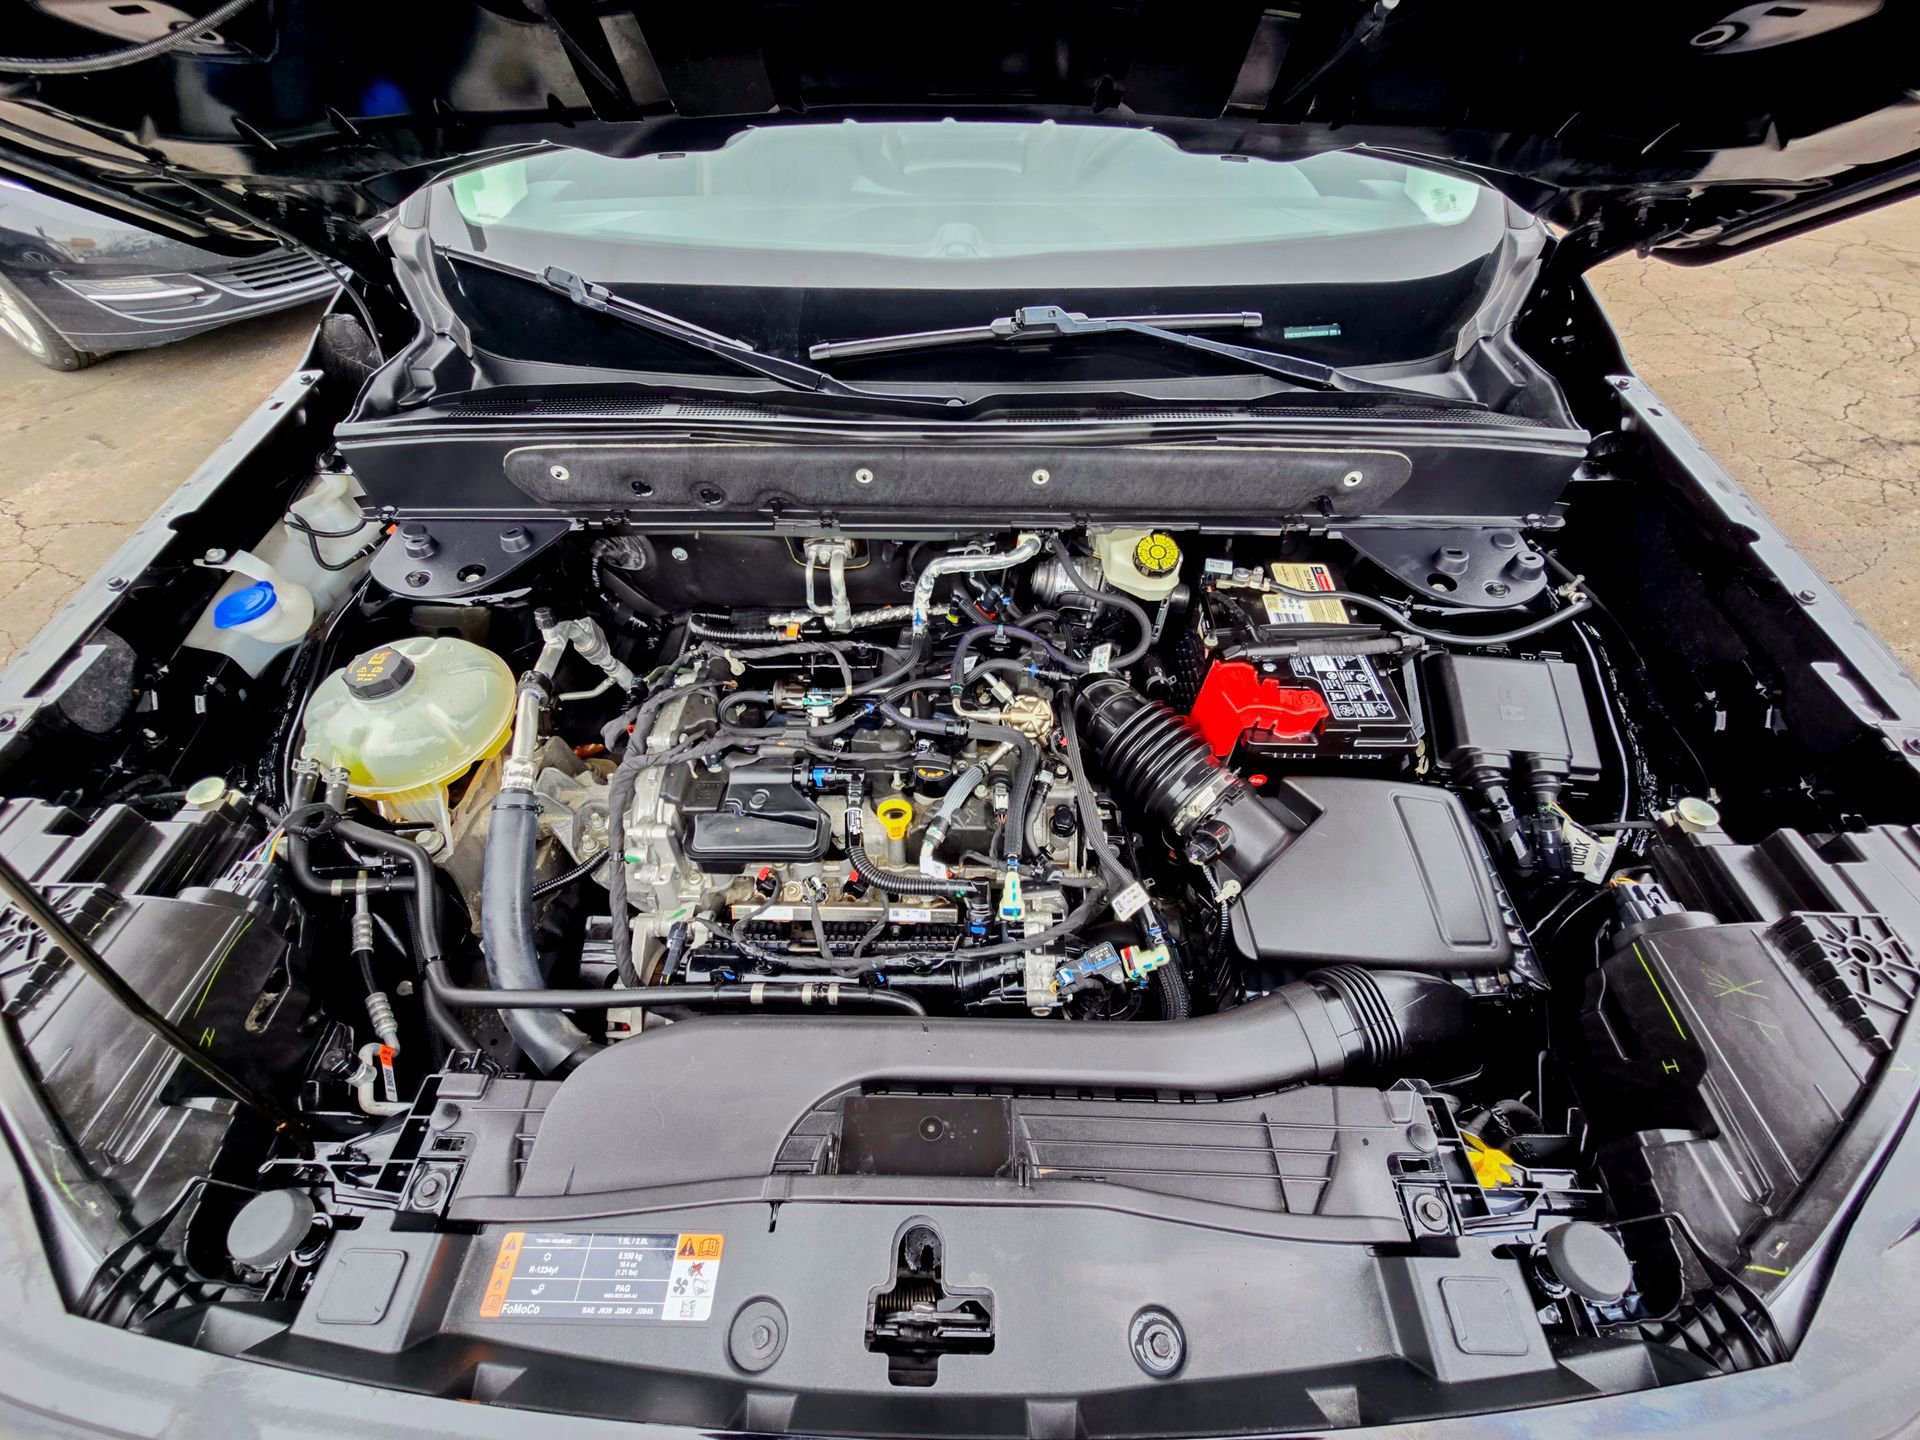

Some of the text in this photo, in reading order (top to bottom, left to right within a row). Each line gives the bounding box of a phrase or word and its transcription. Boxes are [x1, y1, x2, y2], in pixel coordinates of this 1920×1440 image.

[528, 1265, 560, 1276] R-1234yf
[614, 1284, 631, 1293] PAG
[501, 1303, 541, 1315] FoMoCo
[581, 1306, 596, 1314] SAE
